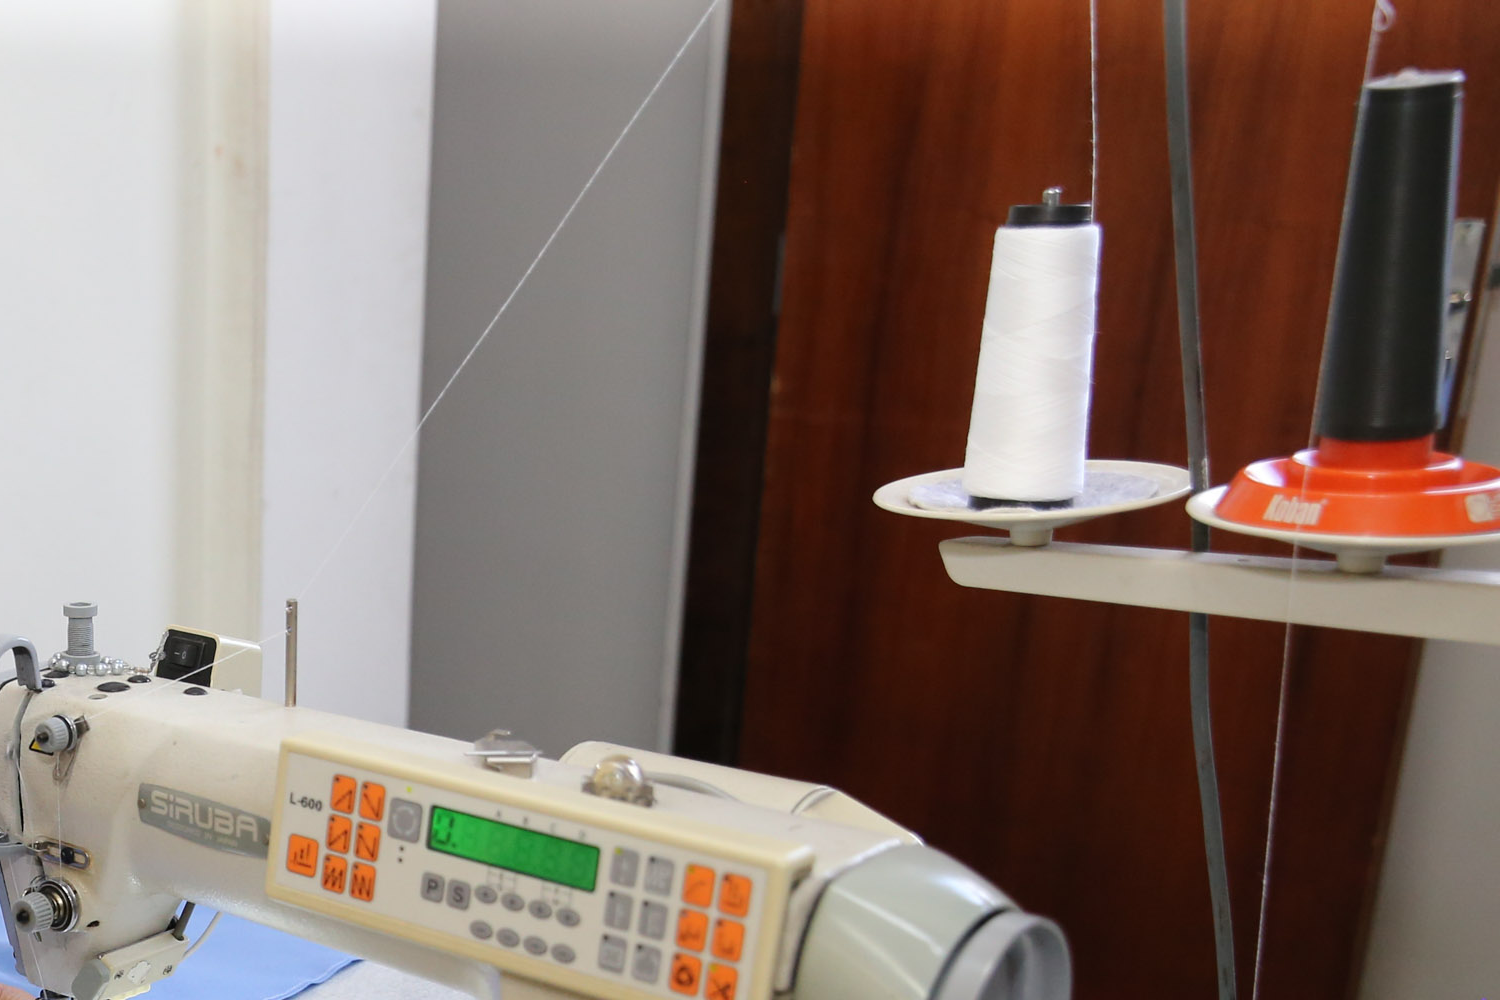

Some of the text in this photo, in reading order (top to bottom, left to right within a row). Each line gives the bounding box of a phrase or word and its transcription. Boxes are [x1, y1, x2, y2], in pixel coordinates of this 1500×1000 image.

[1263, 494, 1323, 526] Koban
[289, 792, 323, 812] L-600
[426, 878, 439, 895] P
[452, 885, 464, 904] S
